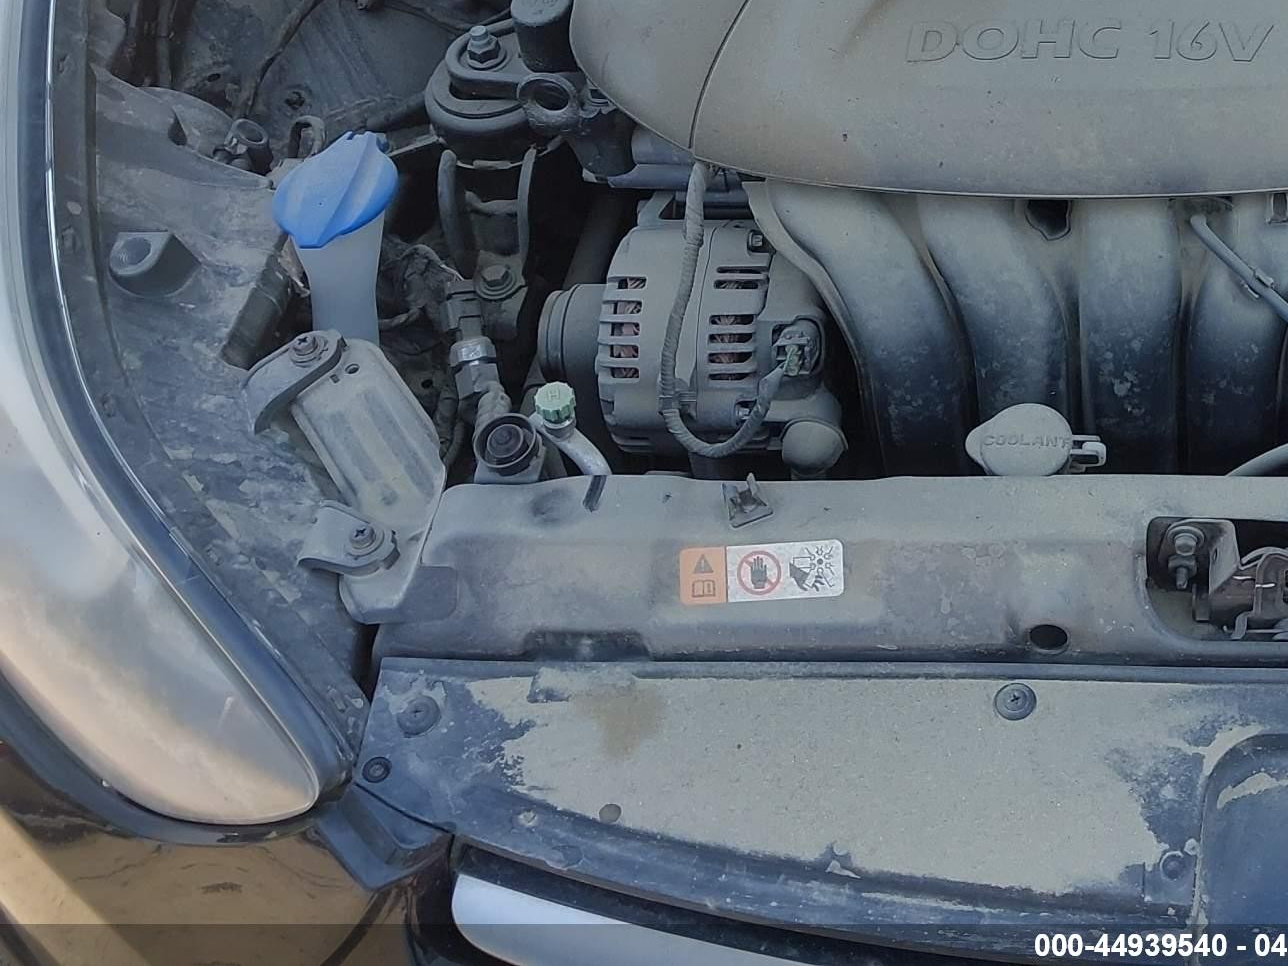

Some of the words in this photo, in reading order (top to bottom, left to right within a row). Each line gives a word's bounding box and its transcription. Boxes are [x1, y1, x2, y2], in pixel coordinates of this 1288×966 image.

[906, 18, 1122, 63] DOHC
[1149, 20, 1275, 62] 16V
[982, 434, 1070, 449] COOLANT
